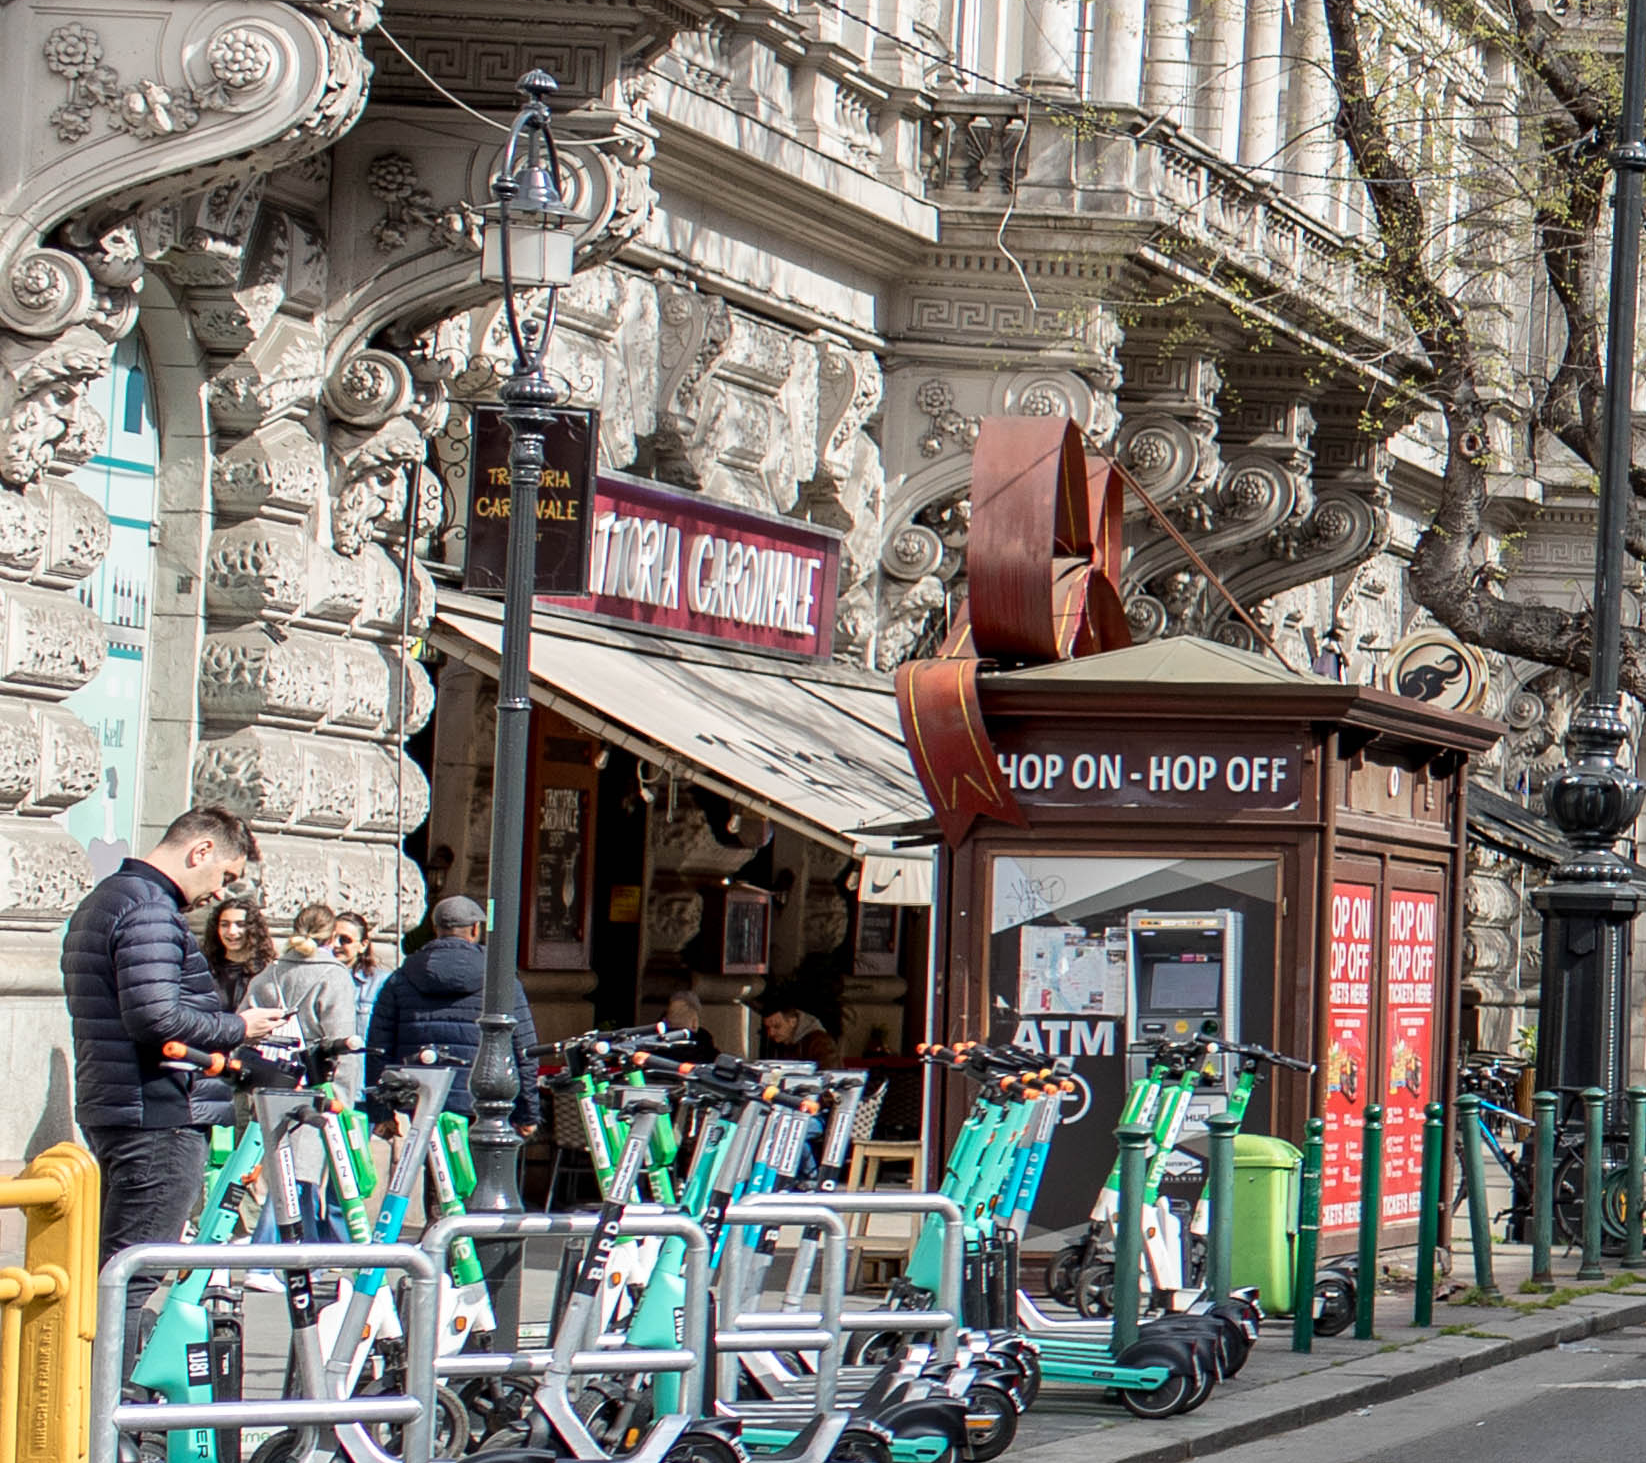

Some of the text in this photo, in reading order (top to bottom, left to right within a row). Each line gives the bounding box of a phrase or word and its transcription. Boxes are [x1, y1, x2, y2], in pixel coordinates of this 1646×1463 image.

[488, 467, 571, 489] TRORIA
[476, 496, 579, 521] CARALE
[688, 534, 821, 635] CARDINALE
[1072, 754, 1122, 789] ON
[1149, 755, 1218, 791] HOP
[1226, 756, 1288, 793] OFF
[1332, 895, 1371, 939] OP ON
[1391, 900, 1434, 941] HOP ON
[1331, 942, 1370, 980] OP OFF
[1389, 945, 1433, 981] HOP OFF
[1013, 1020, 1114, 1056] ATM
[1018, 1150, 1040, 1198] BIRD
[587, 1221, 620, 1280] BIRD
[291, 1269, 310, 1310] RD
[196, 1429, 209, 1459] ER
